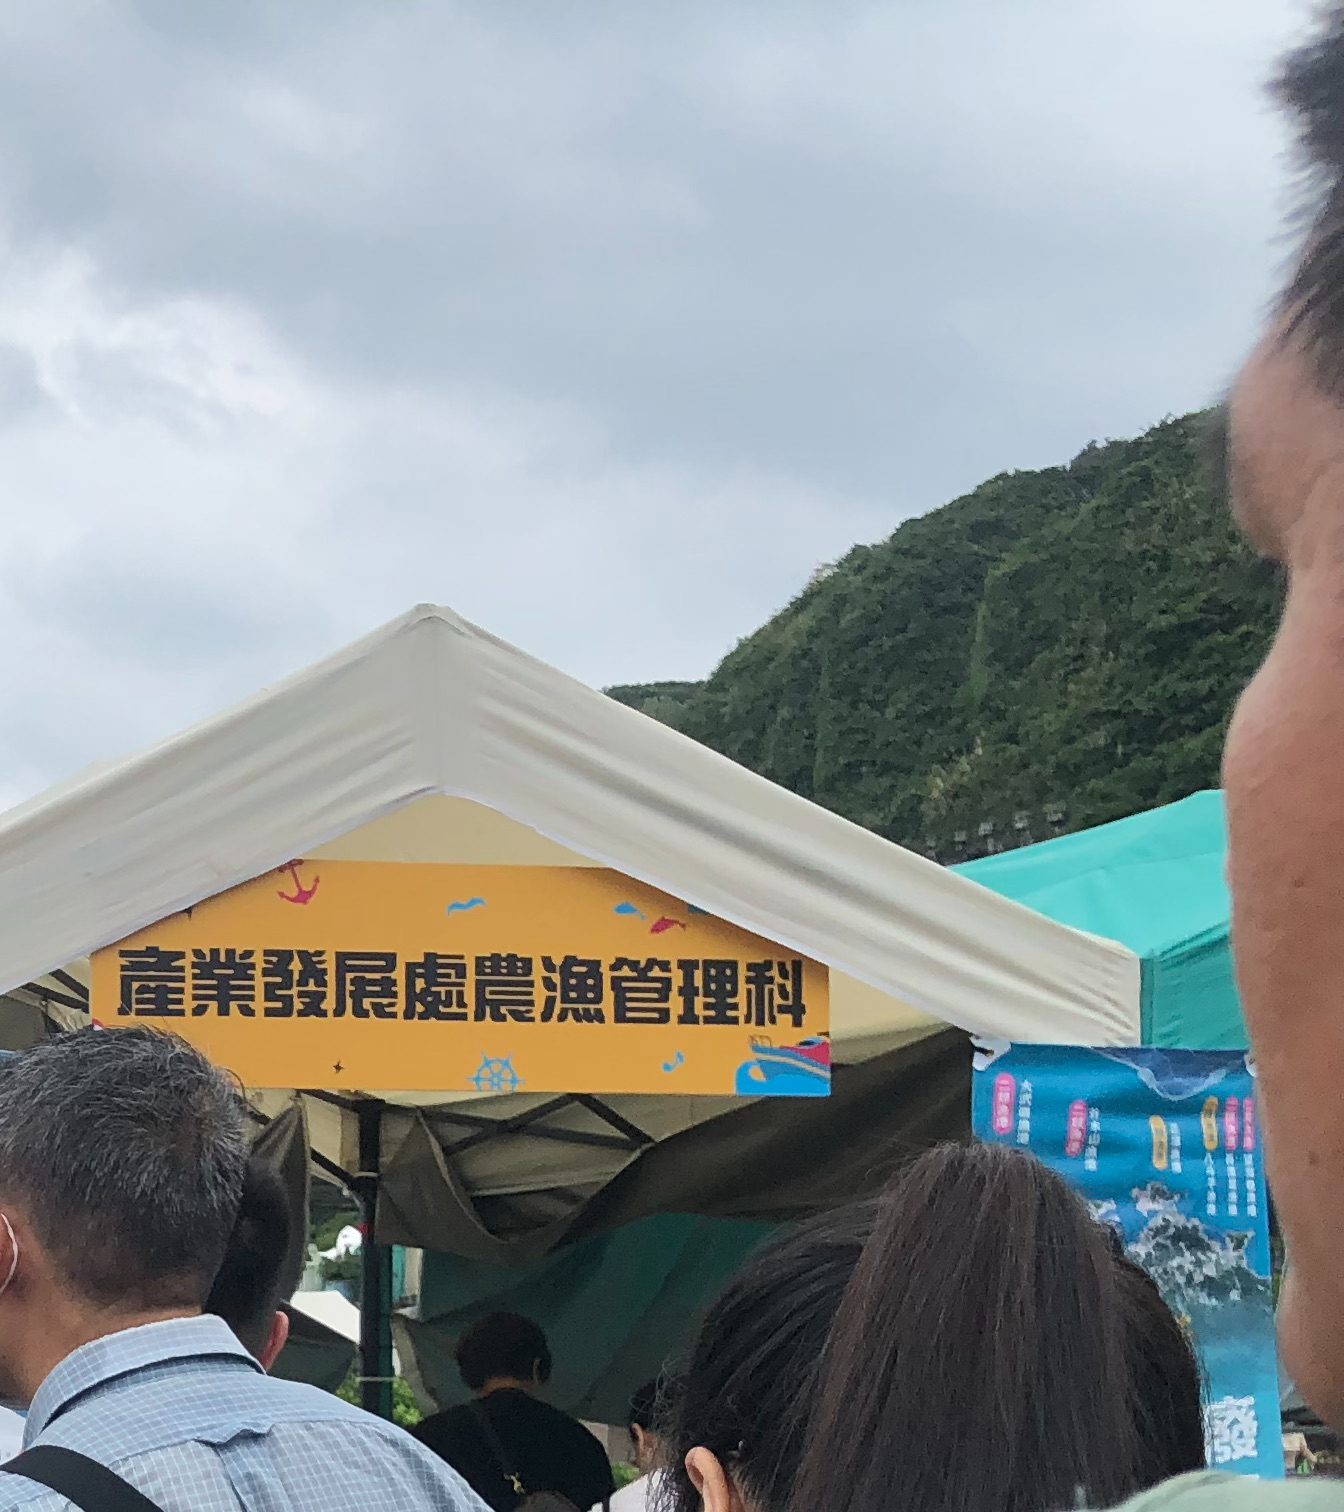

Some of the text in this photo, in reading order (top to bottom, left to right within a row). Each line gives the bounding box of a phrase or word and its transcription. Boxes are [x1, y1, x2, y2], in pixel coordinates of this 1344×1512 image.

[117, 946, 807, 1028] 產業發展處農漁管理科
